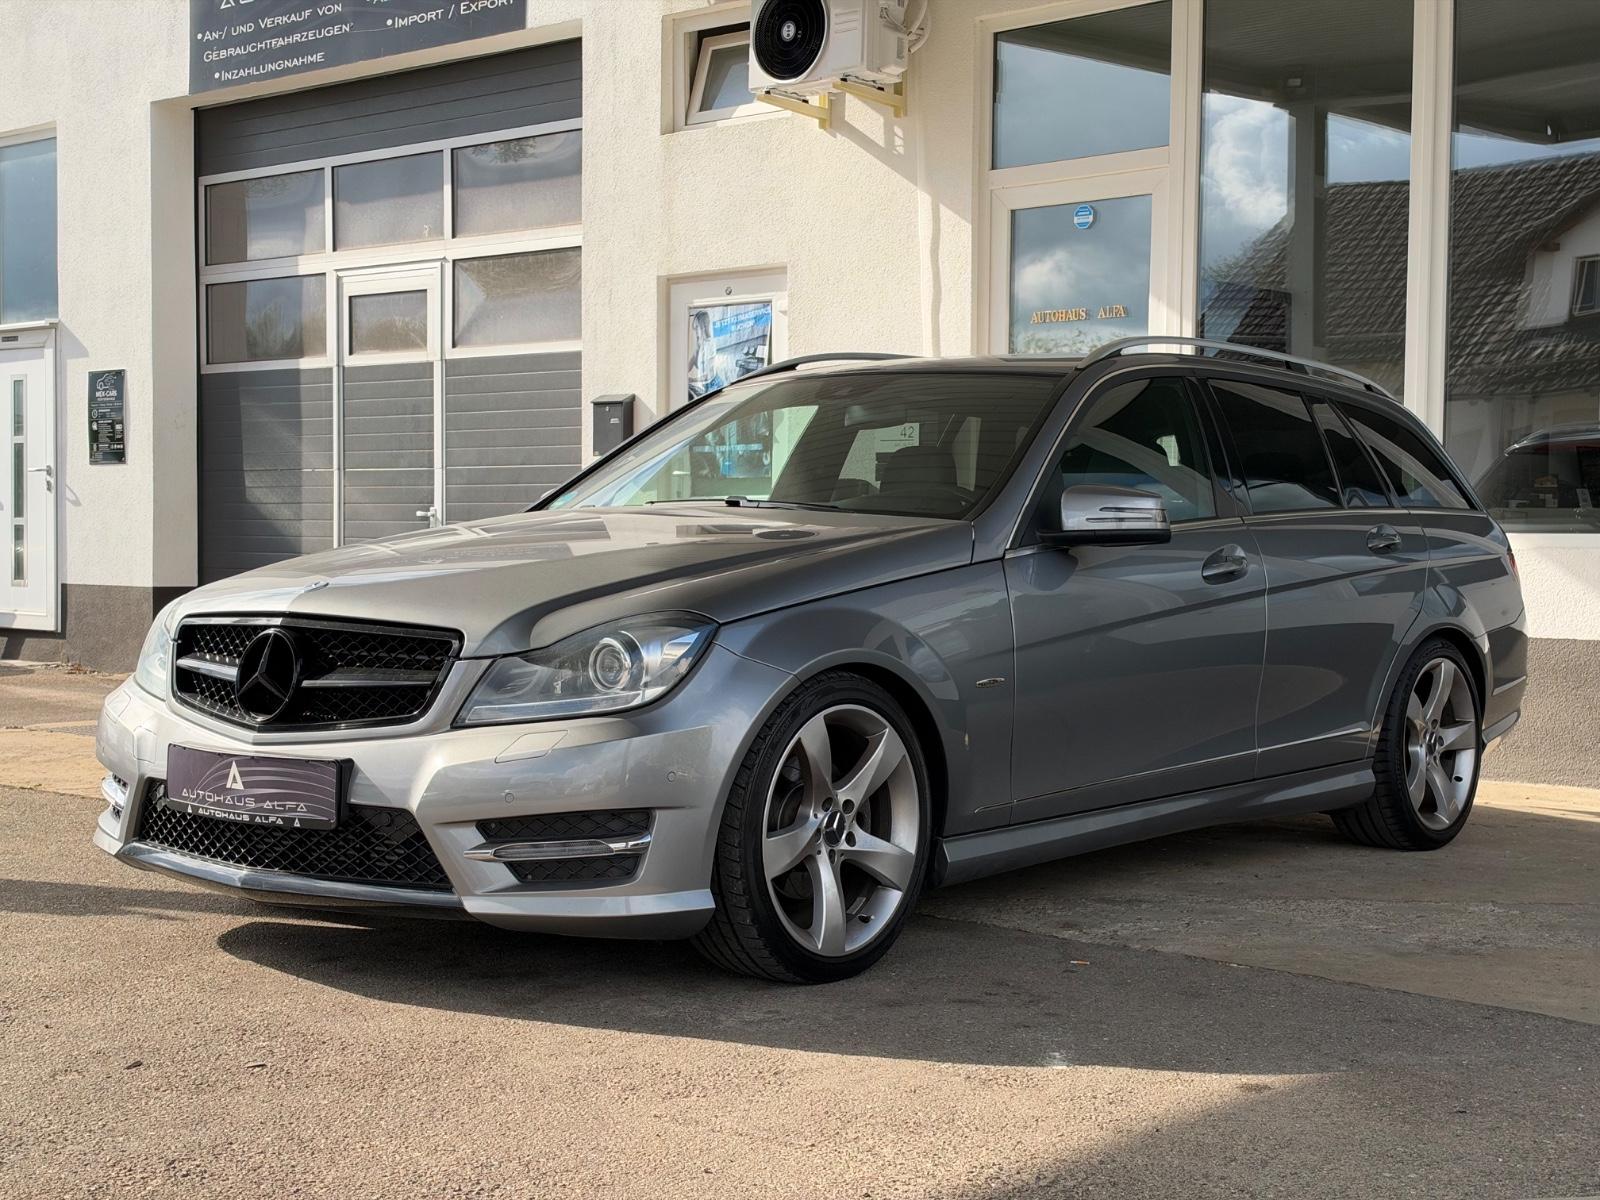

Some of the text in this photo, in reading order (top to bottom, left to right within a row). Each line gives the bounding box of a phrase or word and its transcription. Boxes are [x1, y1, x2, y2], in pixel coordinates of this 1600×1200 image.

[231, 22, 255, 36] UND
[258, 9, 313, 29] VERKAUF
[317, 3, 342, 16] VON
[394, 8, 444, 29] IMPORT
[203, 23, 350, 62] GEBRAUCHTFAHRZEUGEN
[221, 52, 325, 81] INZAHLUNGNAHME
[1030, 304, 1126, 325] AUTOHAUS ALFA
[900, 425, 915, 439] 42
[181, 787, 308, 813] AUTOHAUS ALFA
[198, 807, 284, 825] AUTOHAUS ALFA
